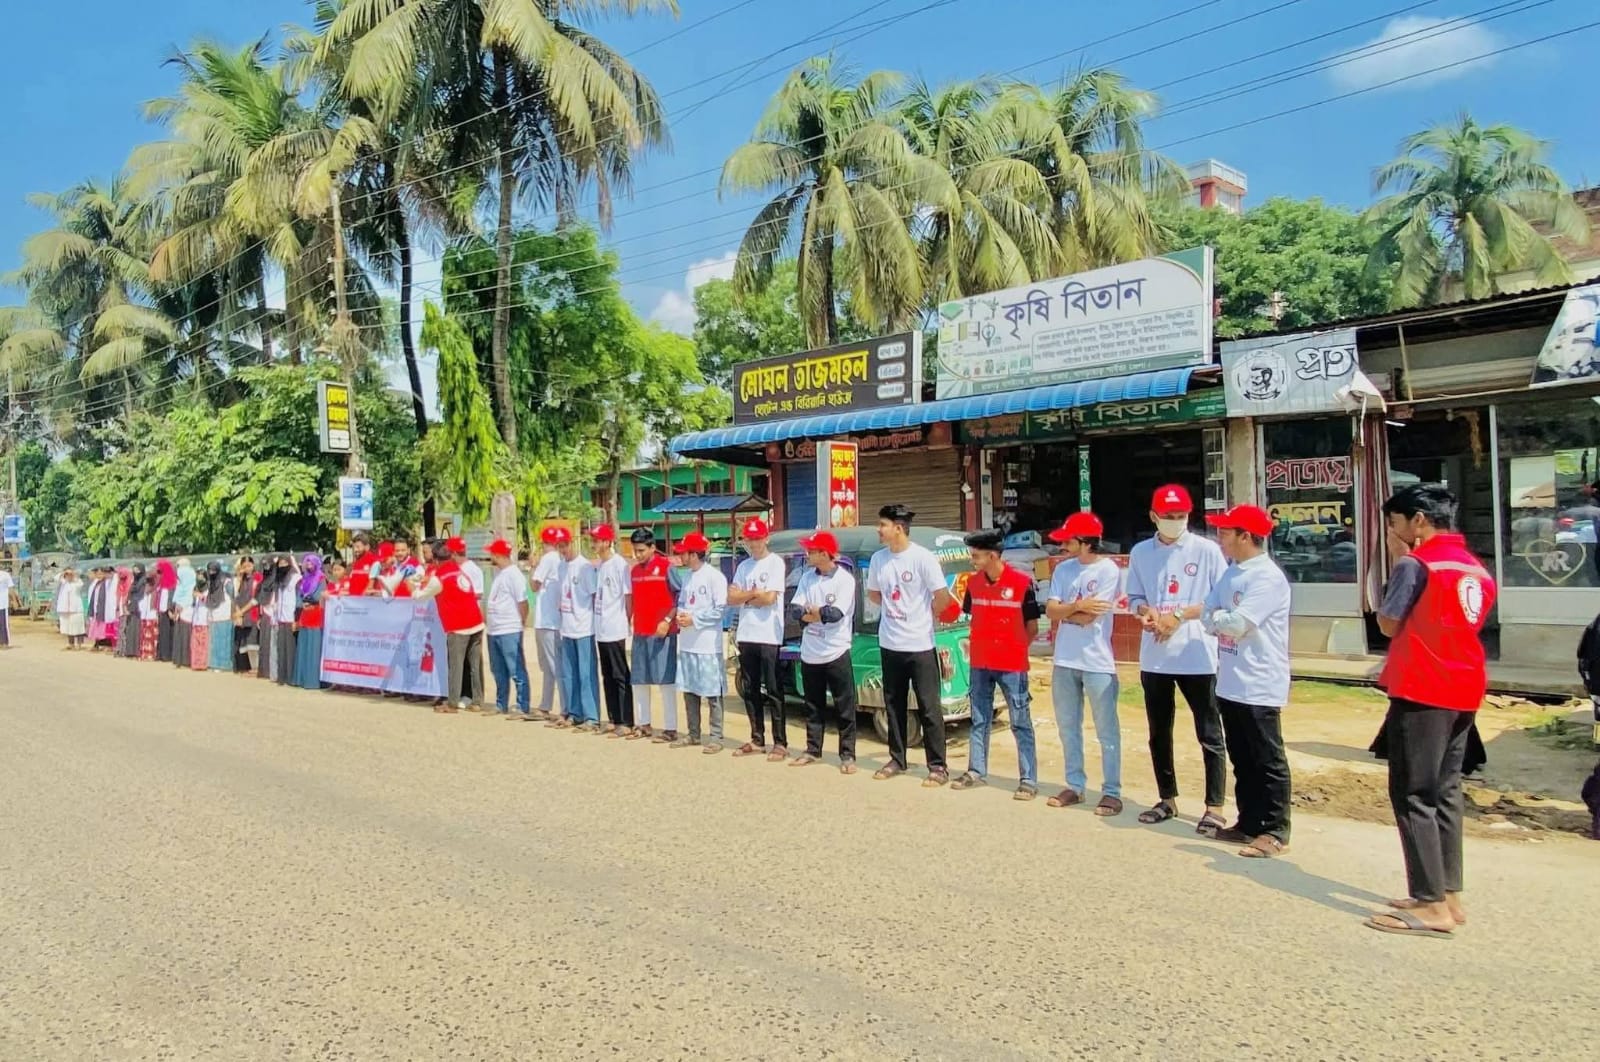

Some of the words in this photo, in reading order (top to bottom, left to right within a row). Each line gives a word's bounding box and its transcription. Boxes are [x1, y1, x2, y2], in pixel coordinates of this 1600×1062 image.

[1001, 289, 1053, 340] কৃষি
[1060, 278, 1147, 319] বিতান
[793, 350, 870, 390] তাজমহল
[1094, 398, 1185, 421] বিতান
